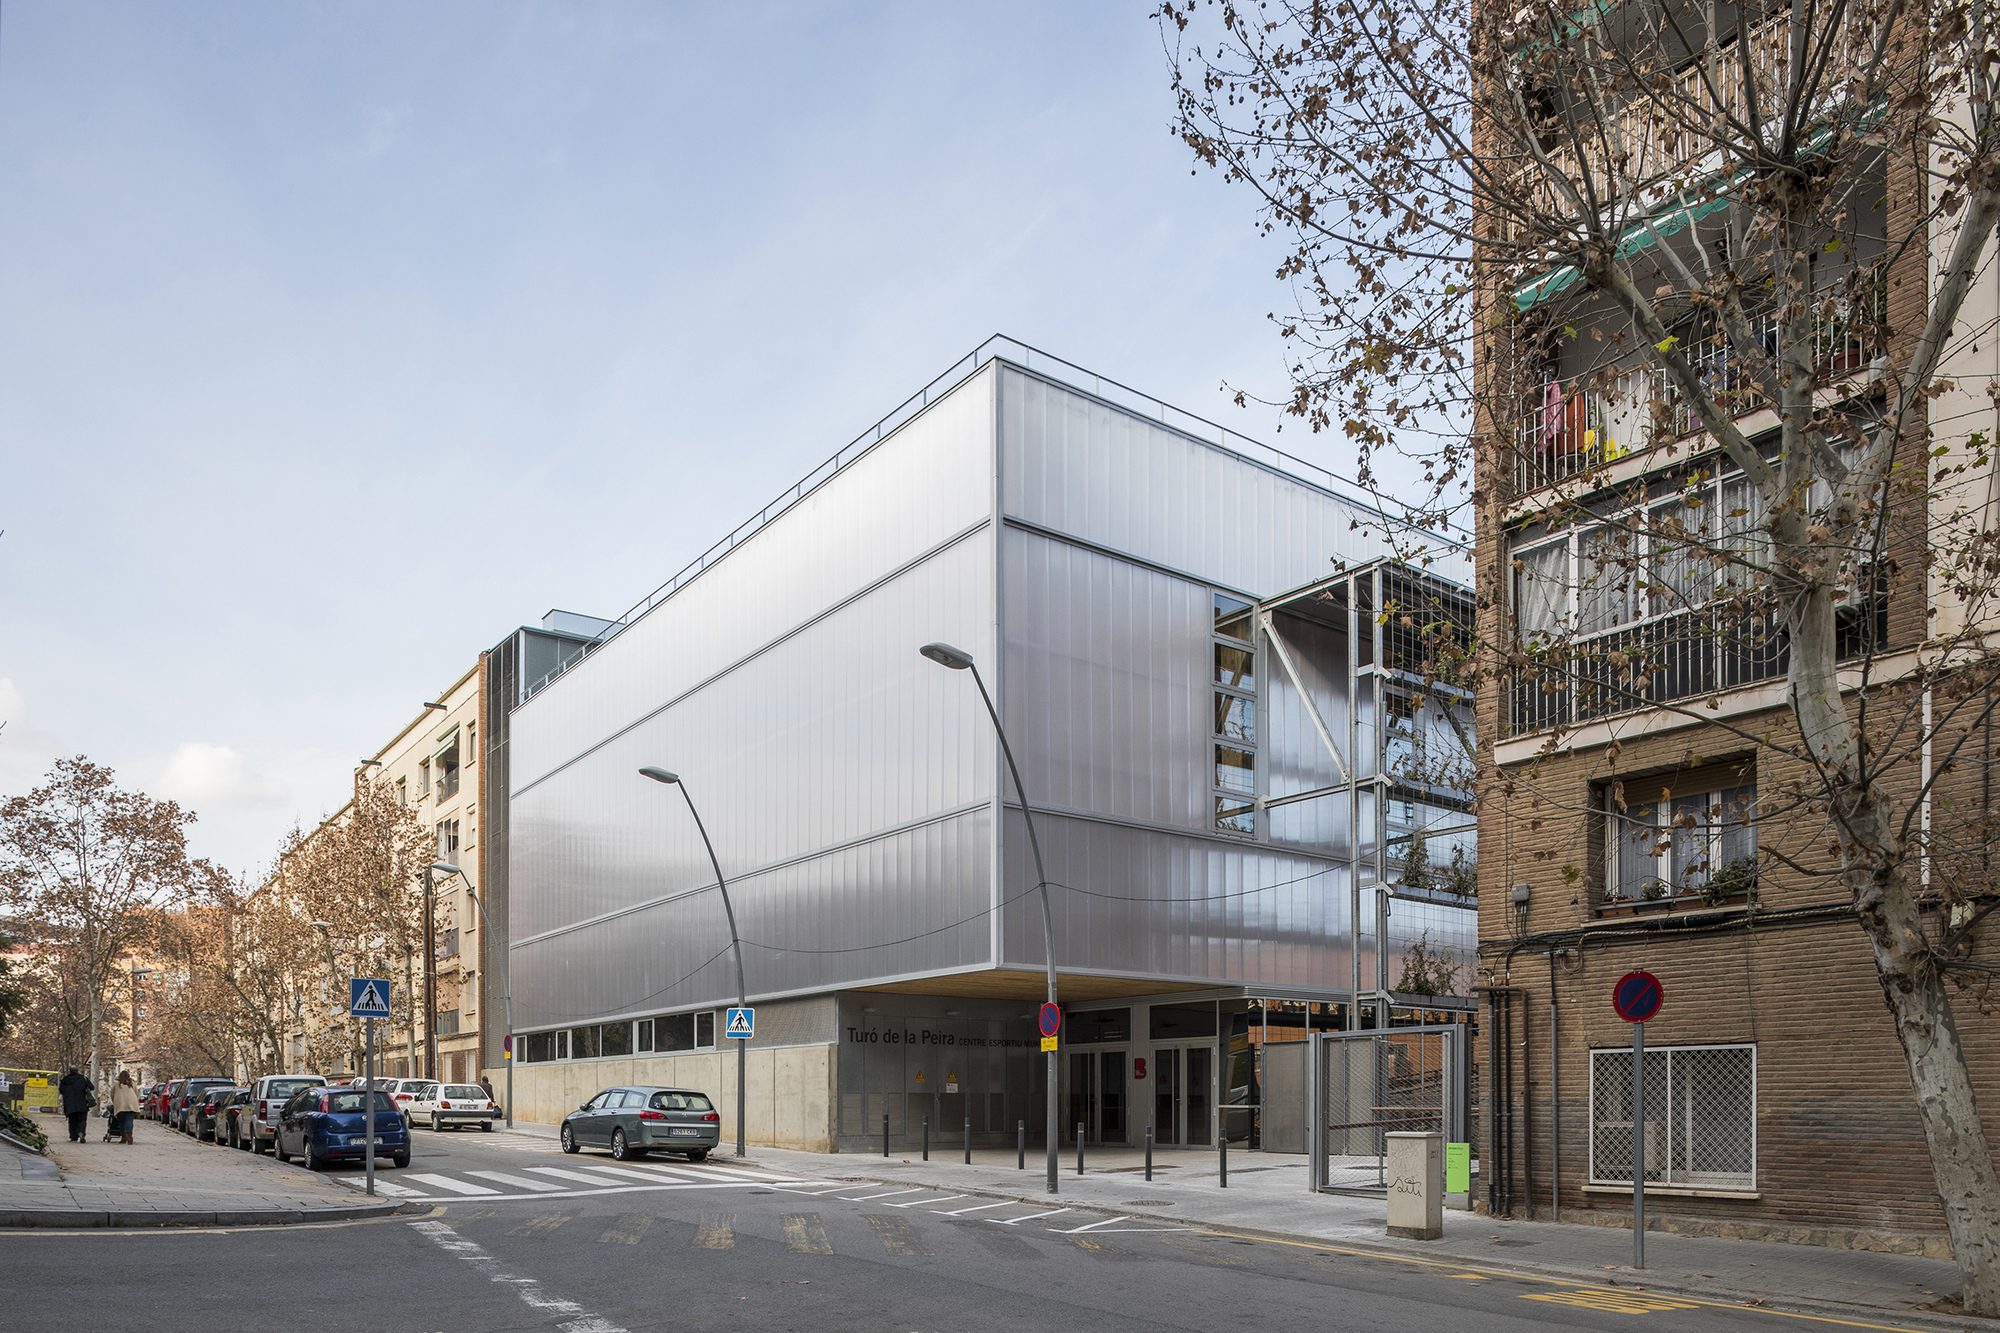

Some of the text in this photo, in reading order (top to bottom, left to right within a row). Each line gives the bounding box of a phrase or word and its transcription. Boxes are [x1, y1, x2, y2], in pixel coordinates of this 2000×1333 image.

[847, 1027, 878, 1043] Turó
[883, 1028, 899, 1044] de
[904, 1029, 916, 1044] la
[922, 1029, 954, 1045] Peira
[959, 1038, 987, 1047] CENTRE
[989, 1039, 1022, 1048] ESPORTIU
